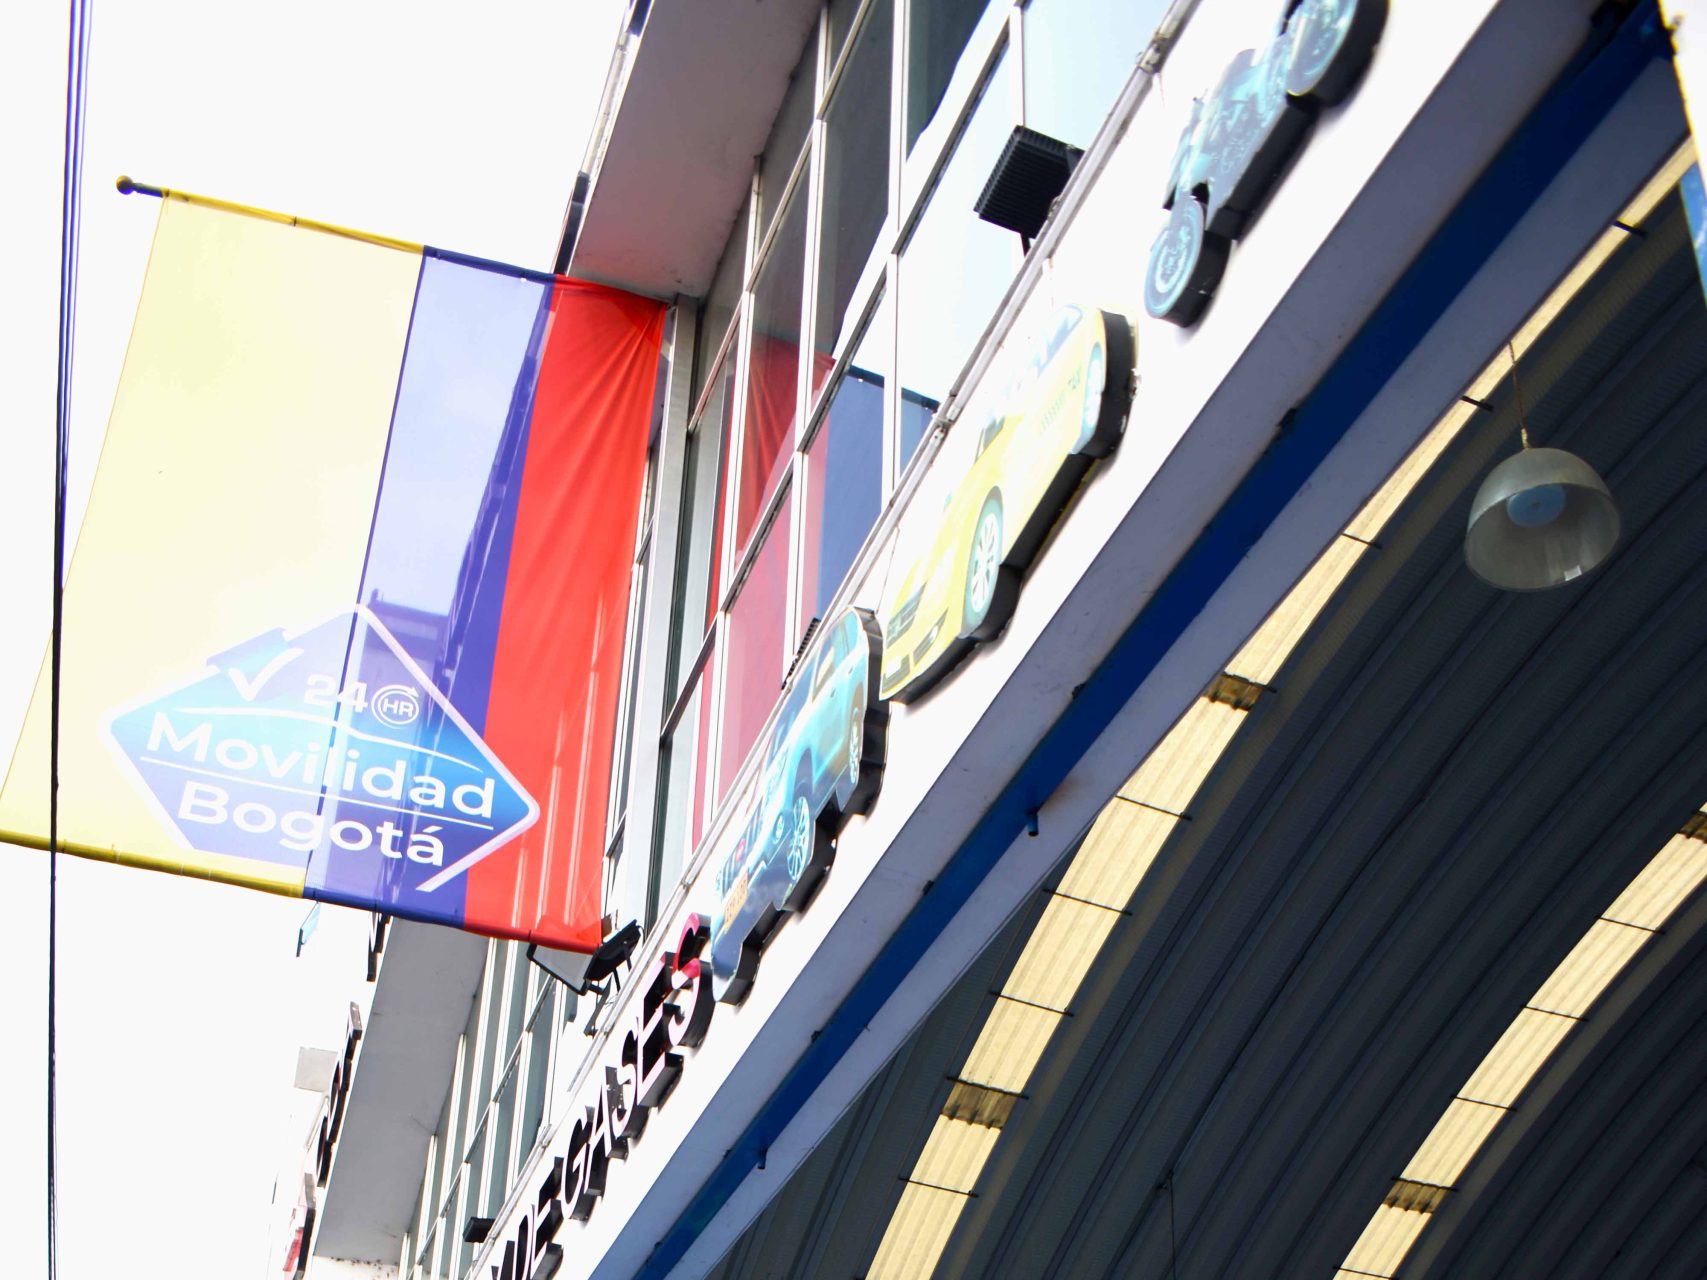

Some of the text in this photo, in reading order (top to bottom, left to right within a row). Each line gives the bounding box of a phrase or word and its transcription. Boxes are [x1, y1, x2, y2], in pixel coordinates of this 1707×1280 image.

[303, 673, 368, 713] 24
[146, 711, 496, 819] Movilidad
[178, 780, 445, 867] Bogotá
[561, 911, 716, 1222] GASES
